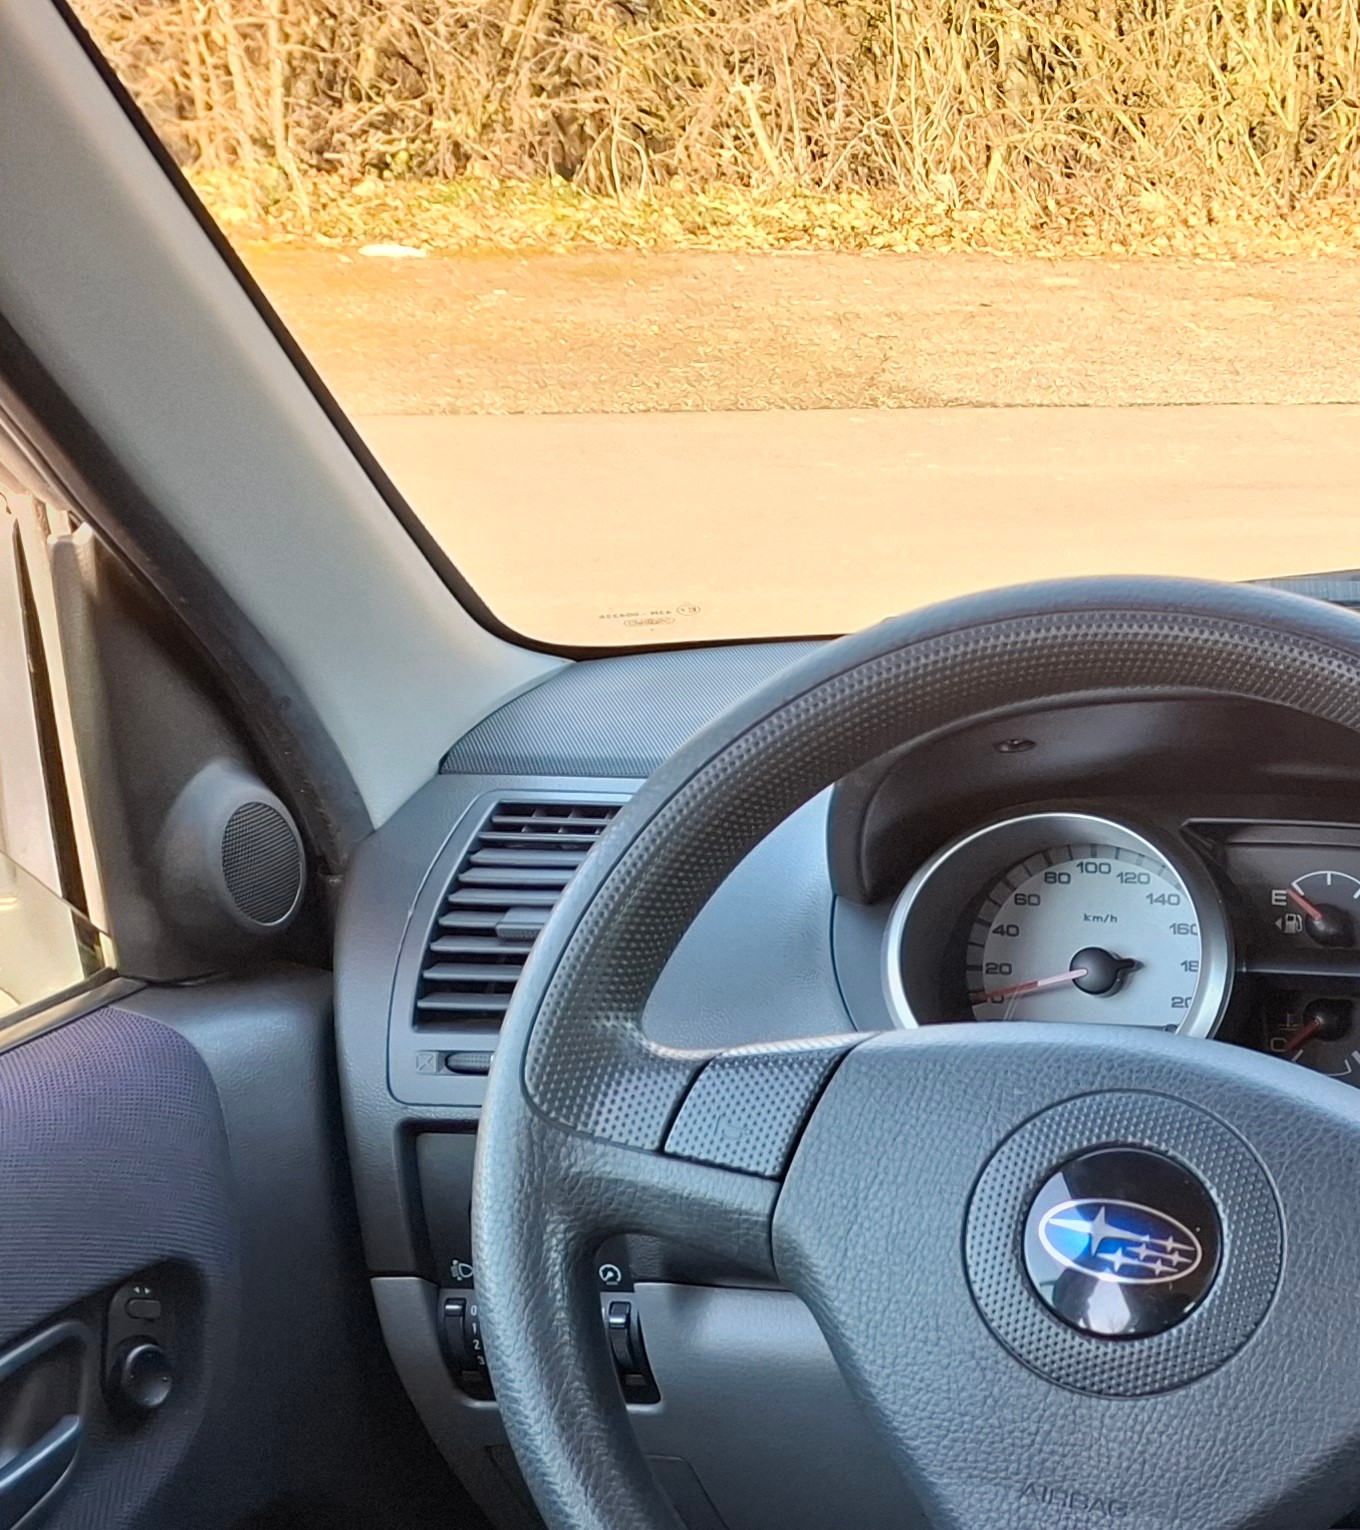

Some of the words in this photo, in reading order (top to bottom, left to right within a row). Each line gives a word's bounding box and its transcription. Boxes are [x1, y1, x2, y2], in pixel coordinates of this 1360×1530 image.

[1076, 861, 1112, 875] 100
[1044, 871, 1071, 884] 80
[1116, 872, 1150, 884] 120
[1014, 893, 1041, 906] 60
[1145, 893, 1181, 906] 140
[1271, 889, 1287, 906] E
[1083, 912, 1118, 923] km/h
[992, 924, 1020, 937] 40
[985, 962, 1013, 975] 20
[1180, 960, 1199, 972] 18
[470, 1305, 477, 1316] 0
[471, 1322, 477, 1334] 1
[472, 1339, 480, 1350] 2
[477, 1355, 485, 1365] 3
[1019, 1480, 1128, 1518] AIRBAG
